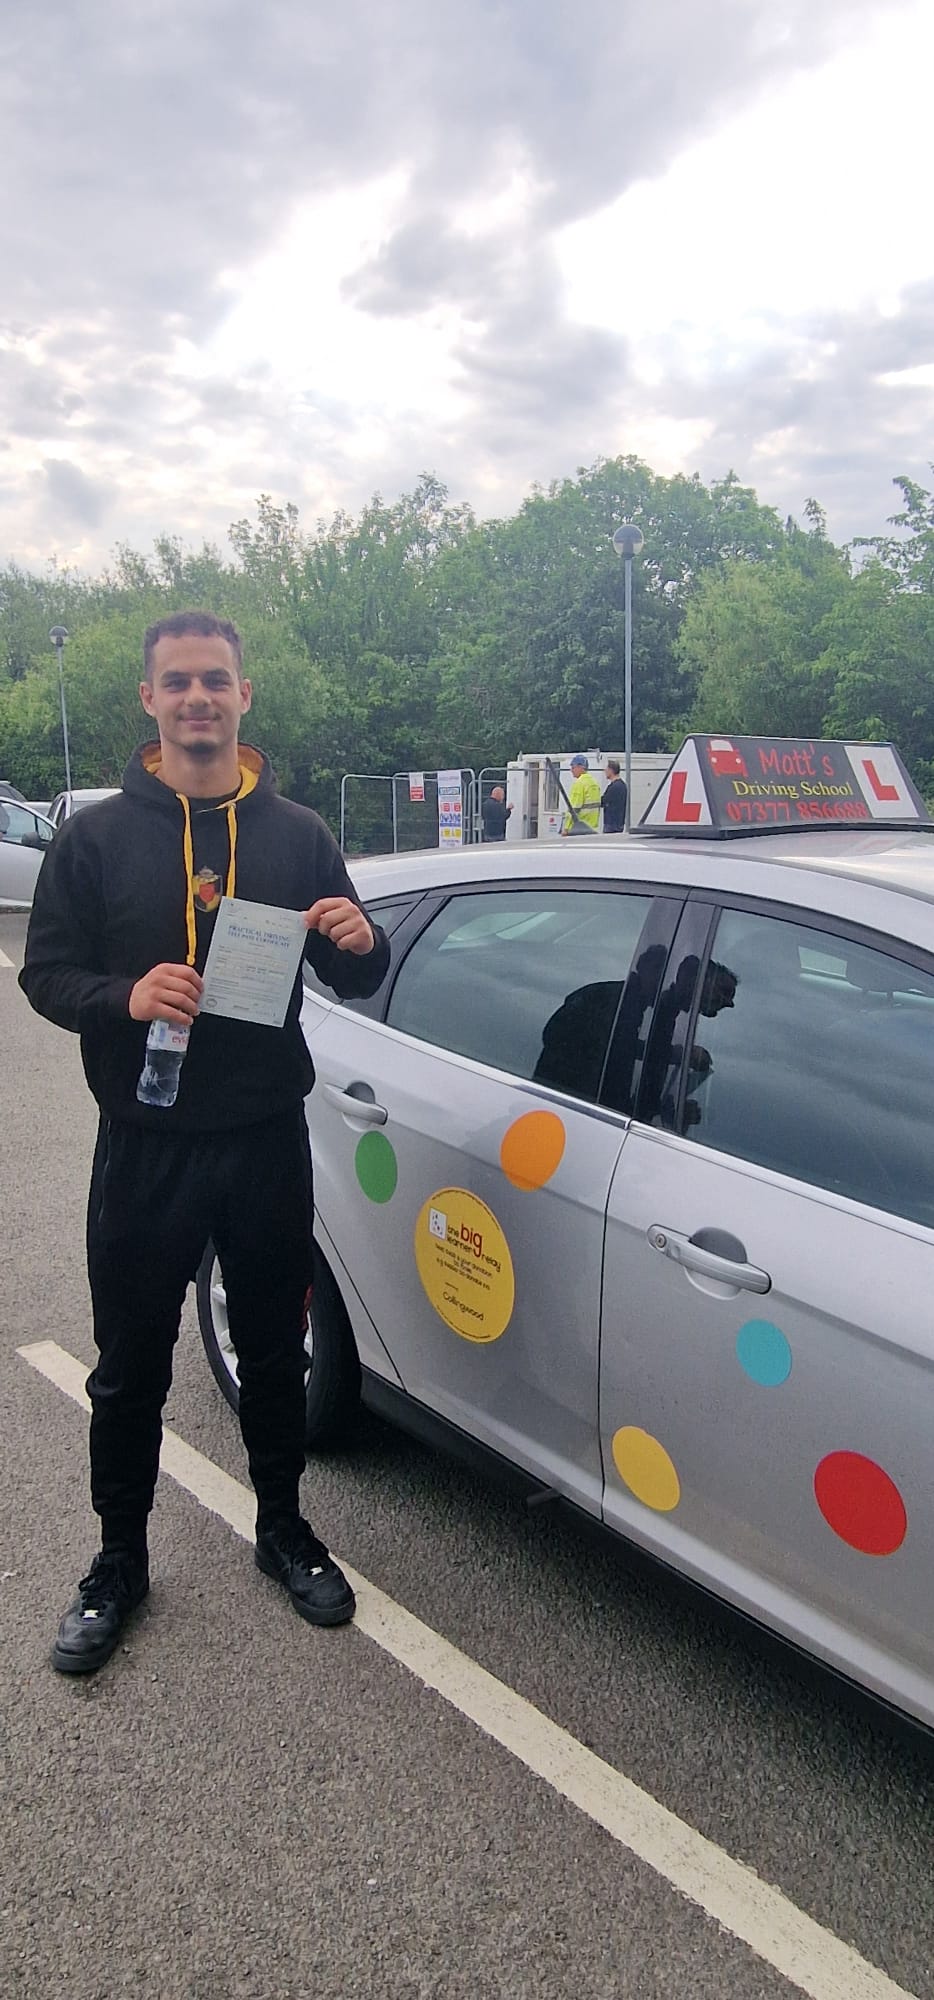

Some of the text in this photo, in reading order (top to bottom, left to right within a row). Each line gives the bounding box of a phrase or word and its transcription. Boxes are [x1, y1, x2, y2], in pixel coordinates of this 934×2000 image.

[759, 744, 834, 776] Matt's
[733, 781, 853, 799] Driving School
[862, 760, 900, 800] L
[665, 772, 702, 822] L
[727, 802, 868, 822] 07377 856688
[447, 1236, 473, 1253] learner
[482, 1254, 501, 1272] relay
[461, 1223, 482, 1257] big
[443, 1291, 484, 1321] Collingwood
